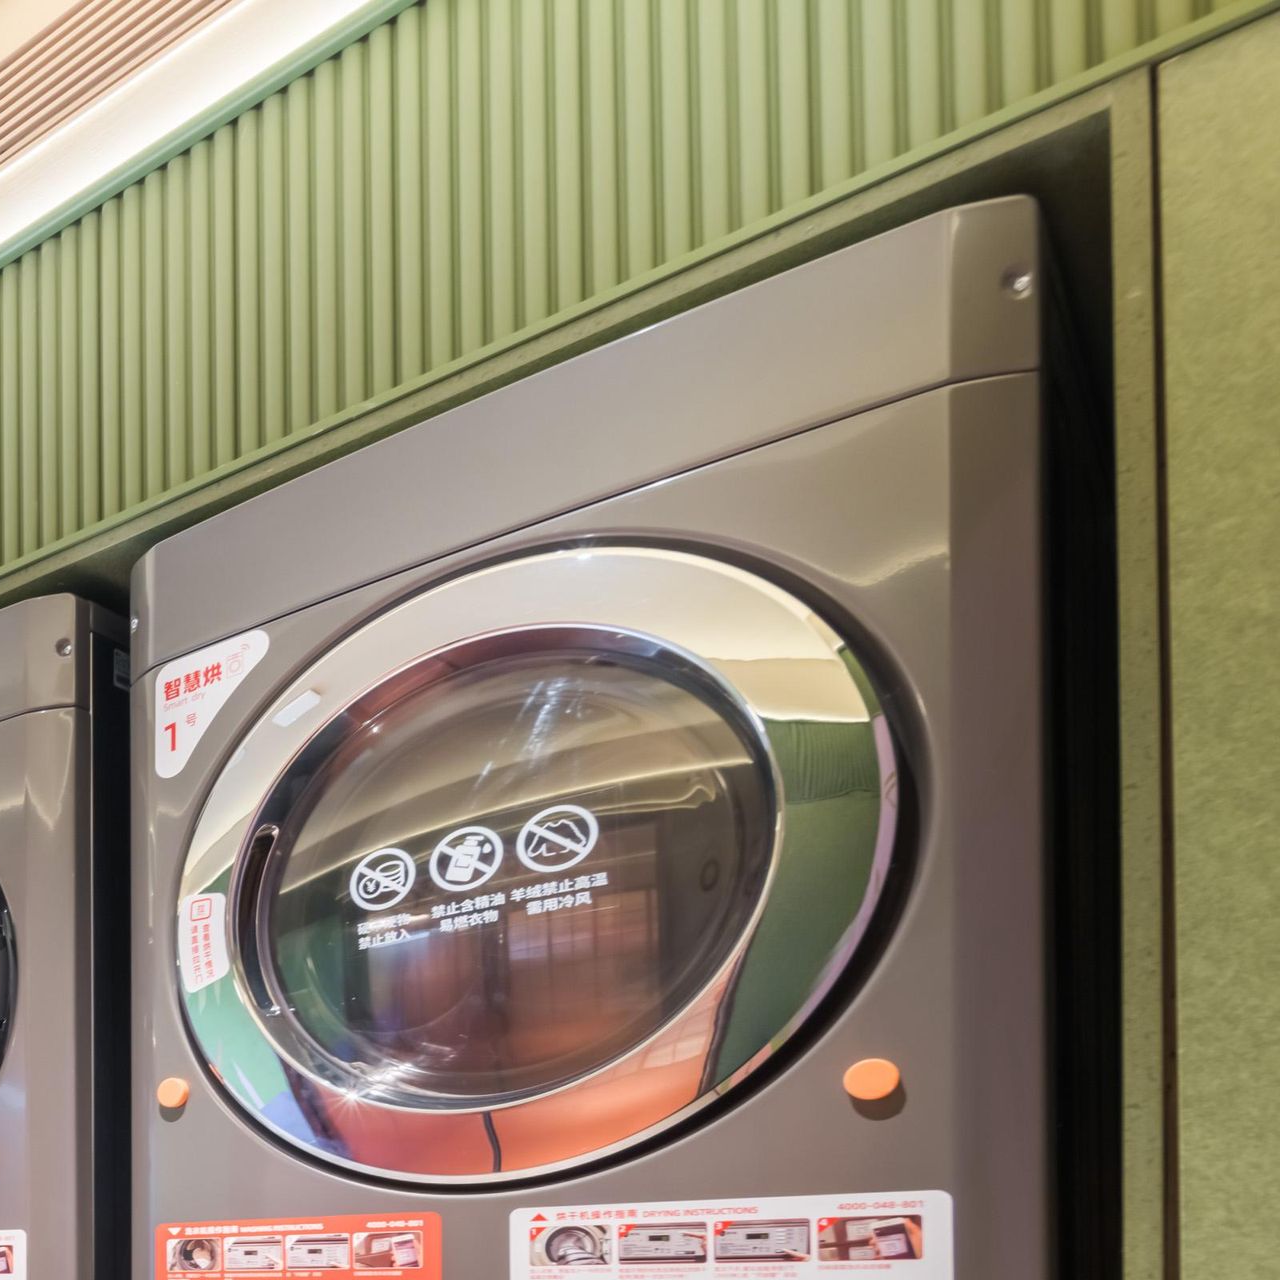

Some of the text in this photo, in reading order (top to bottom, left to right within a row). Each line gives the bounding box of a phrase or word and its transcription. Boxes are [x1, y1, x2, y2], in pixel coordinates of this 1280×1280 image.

[164, 662, 223, 701] 智慧烘
[509, 871, 609, 902] 羊绒禁止高温
[430, 892, 506, 919] 禁止含精油
[439, 909, 500, 933] 易燃衣物
[556, 1206, 759, 1221] 烘干机操作指南 DRYING INSTRUCTIONS
